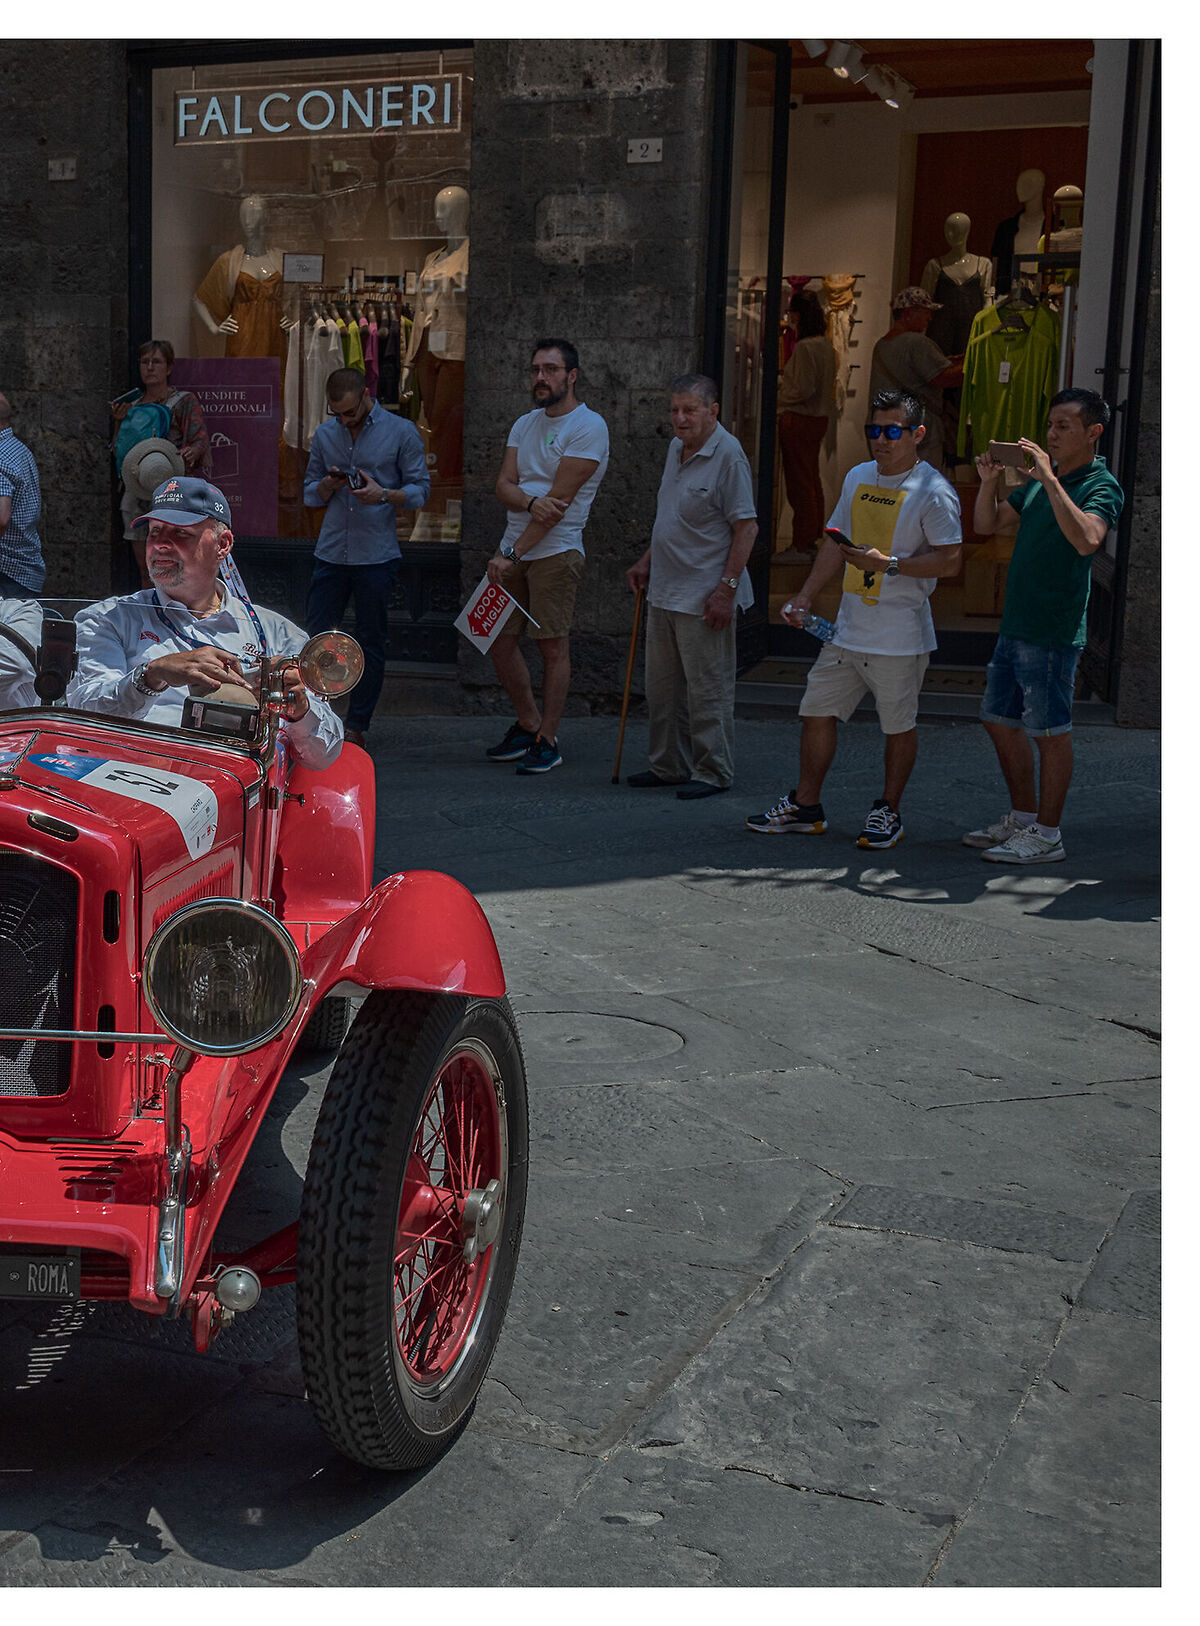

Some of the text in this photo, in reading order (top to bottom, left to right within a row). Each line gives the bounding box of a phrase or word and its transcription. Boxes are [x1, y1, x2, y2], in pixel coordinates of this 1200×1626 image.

[178, 82, 451, 137] FALCONERI
[640, 142, 649, 159] 2
[197, 391, 247, 401] VENDITE
[214, 502, 224, 514] 32
[868, 495, 896, 506] lotto
[473, 587, 497, 620] 1000
[481, 594, 509, 632] MIGLIA
[105, 769, 179, 796] 32
[27, 1262, 70, 1294] ROMA
